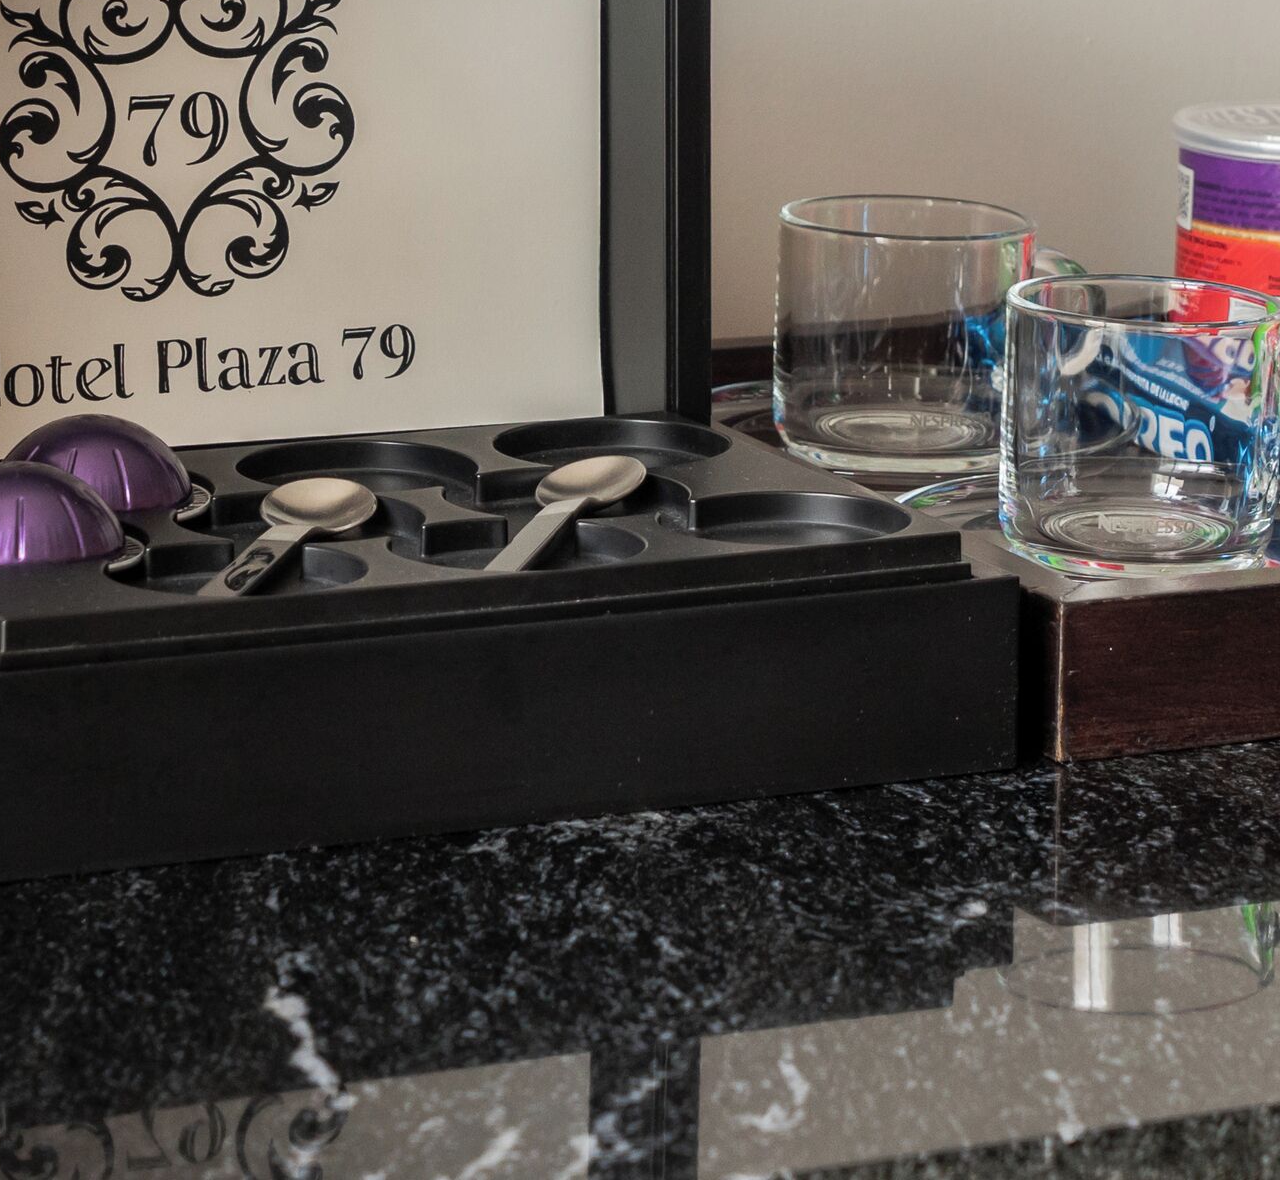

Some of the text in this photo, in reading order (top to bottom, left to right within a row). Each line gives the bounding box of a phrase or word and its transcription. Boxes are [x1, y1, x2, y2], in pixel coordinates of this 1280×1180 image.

[127, 91, 229, 167] 79
[157, 336, 325, 394] Plaza
[341, 323, 417, 381] 79
